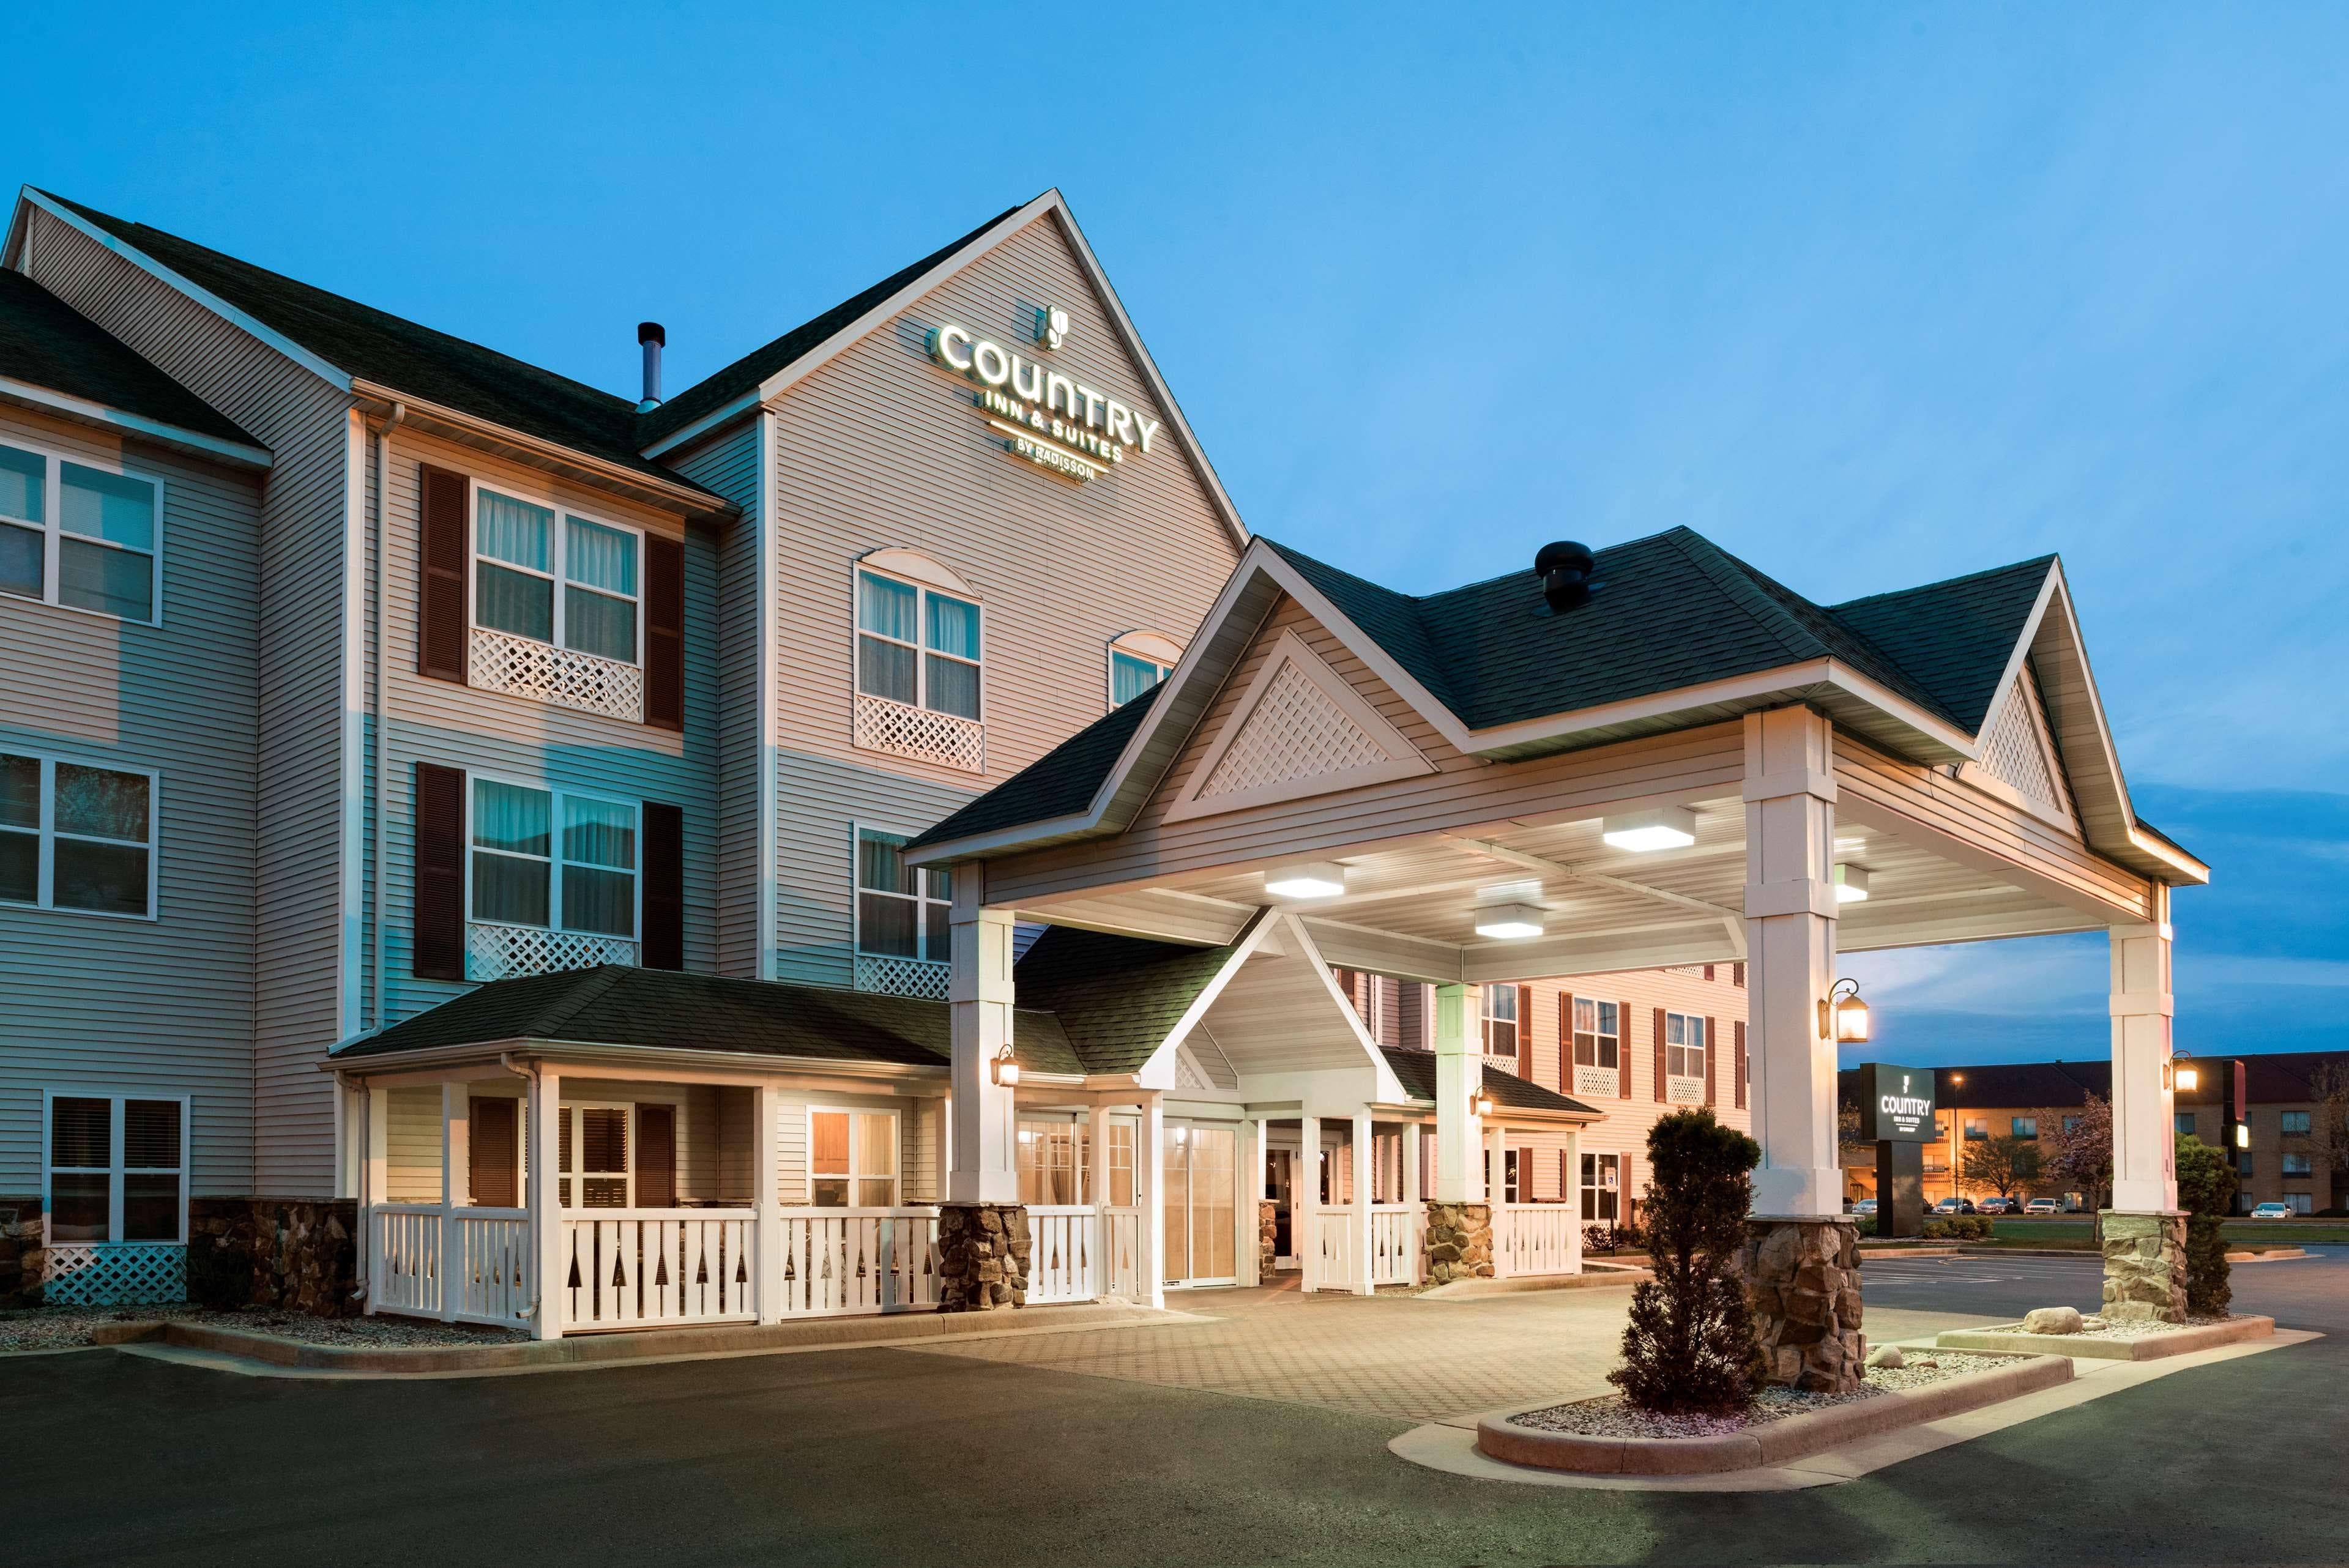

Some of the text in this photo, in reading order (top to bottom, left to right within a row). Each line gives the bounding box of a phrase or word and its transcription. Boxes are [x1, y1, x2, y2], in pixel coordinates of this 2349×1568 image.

[938, 325, 1158, 453] COUNTRY
[986, 389, 1123, 462] INN & SUITES
[1017, 438, 1095, 480] BY RADISSON
[1881, 1096, 1930, 1116] COUNTRY
